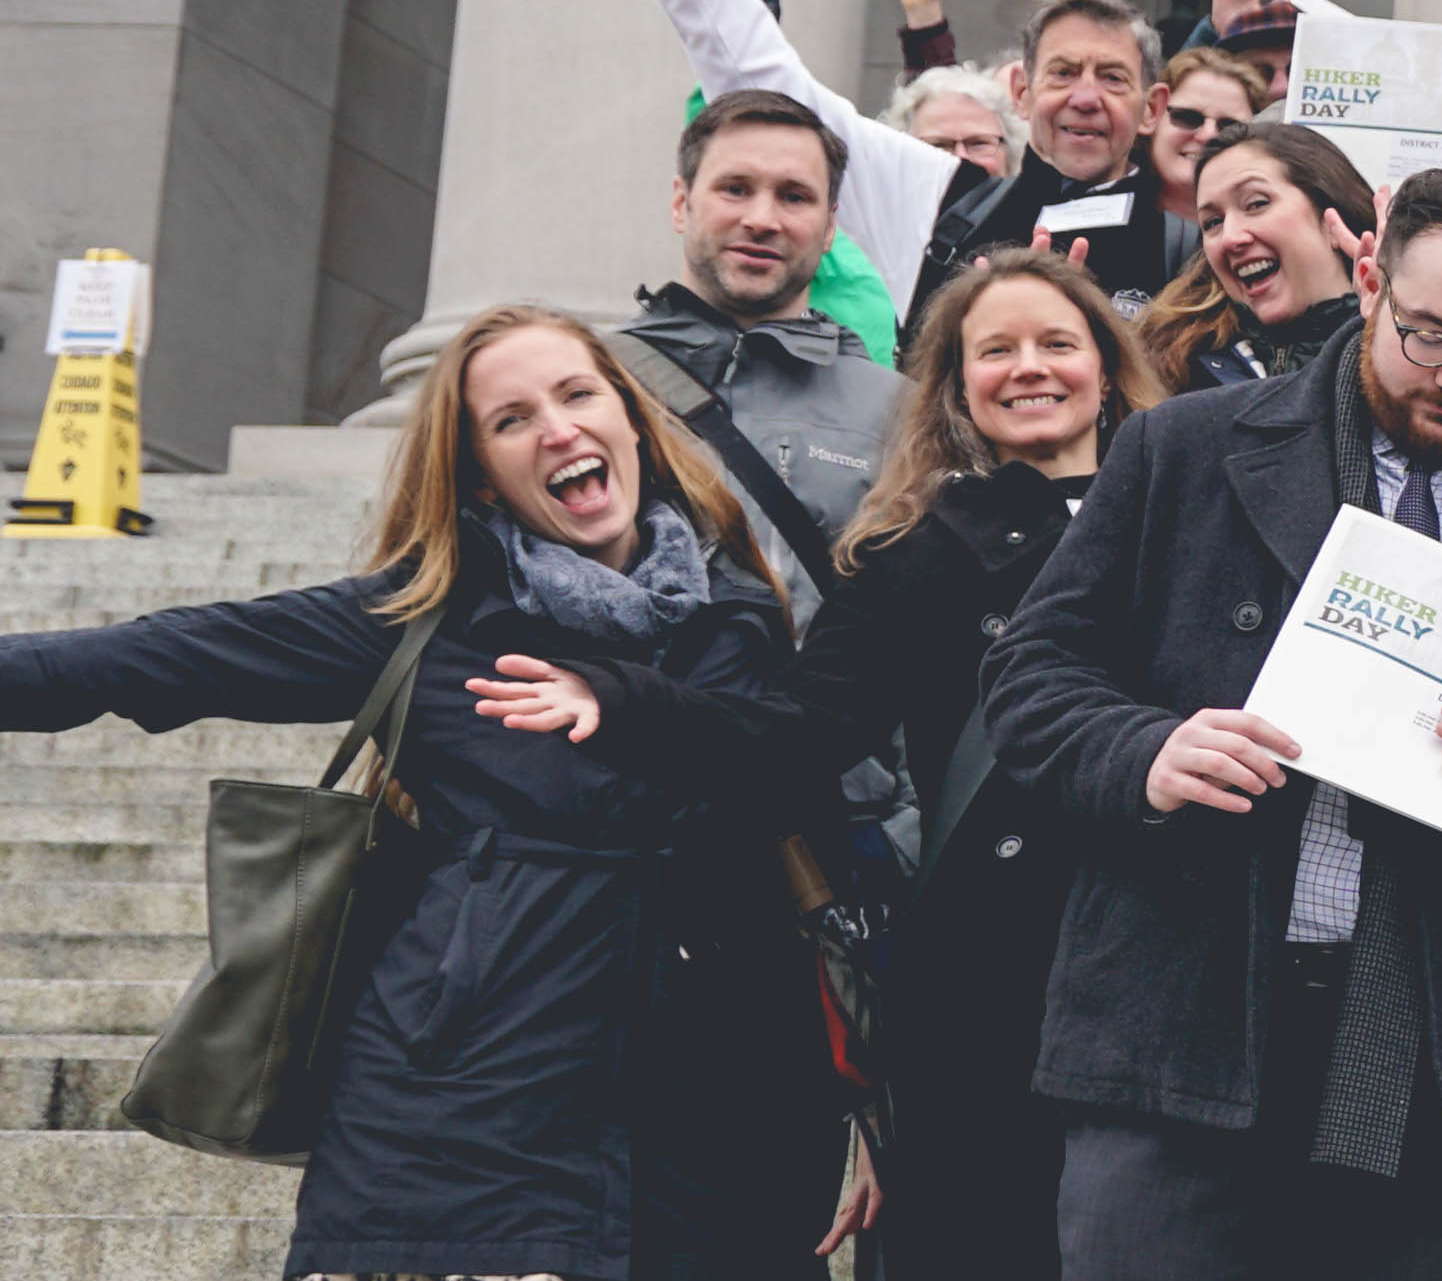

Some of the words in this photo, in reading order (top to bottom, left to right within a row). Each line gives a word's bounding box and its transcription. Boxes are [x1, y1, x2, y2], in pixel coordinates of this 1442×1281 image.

[1303, 68, 1381, 86] HIKER
[1301, 86, 1381, 104] RALLY
[1300, 103, 1350, 118] DAY
[808, 445, 870, 471] Marmot
[1336, 571, 1437, 623] HIKER
[1319, 606, 1390, 642] DAY
[1327, 588, 1435, 640] RALLY
